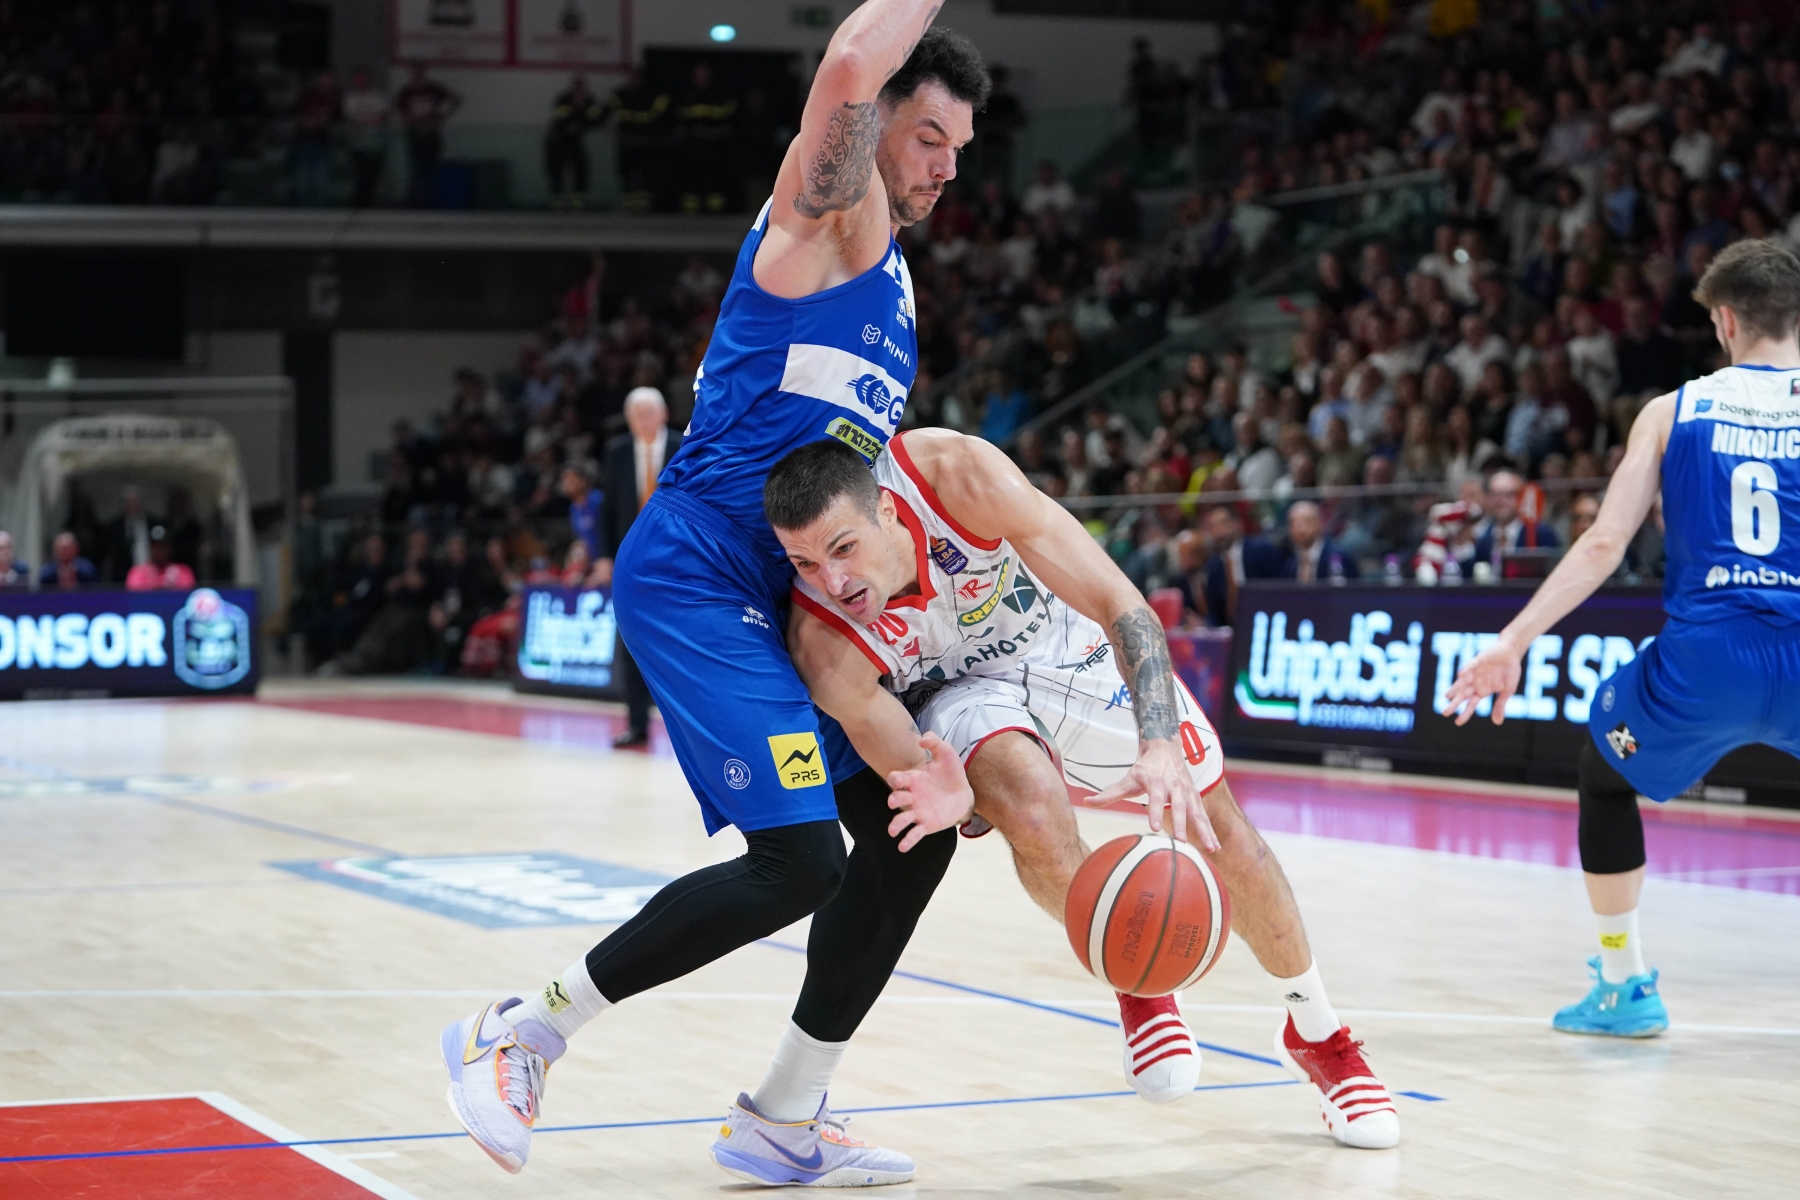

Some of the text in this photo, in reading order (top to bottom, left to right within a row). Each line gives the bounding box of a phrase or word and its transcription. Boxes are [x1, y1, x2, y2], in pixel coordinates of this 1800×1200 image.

[1711, 422, 1800, 459] NIKOLIC
[1731, 460, 1781, 557] 6
[936, 547, 957, 563] LBA
[866, 611, 909, 646] 20
[1249, 610, 1424, 726] UnipolSai
[1563, 634, 1660, 724] SP
[790, 769, 820, 784] PRS
[1121, 891, 1156, 963] molten
[1167, 921, 1193, 958] FIBA
[1183, 924, 1199, 959] APPROVED
